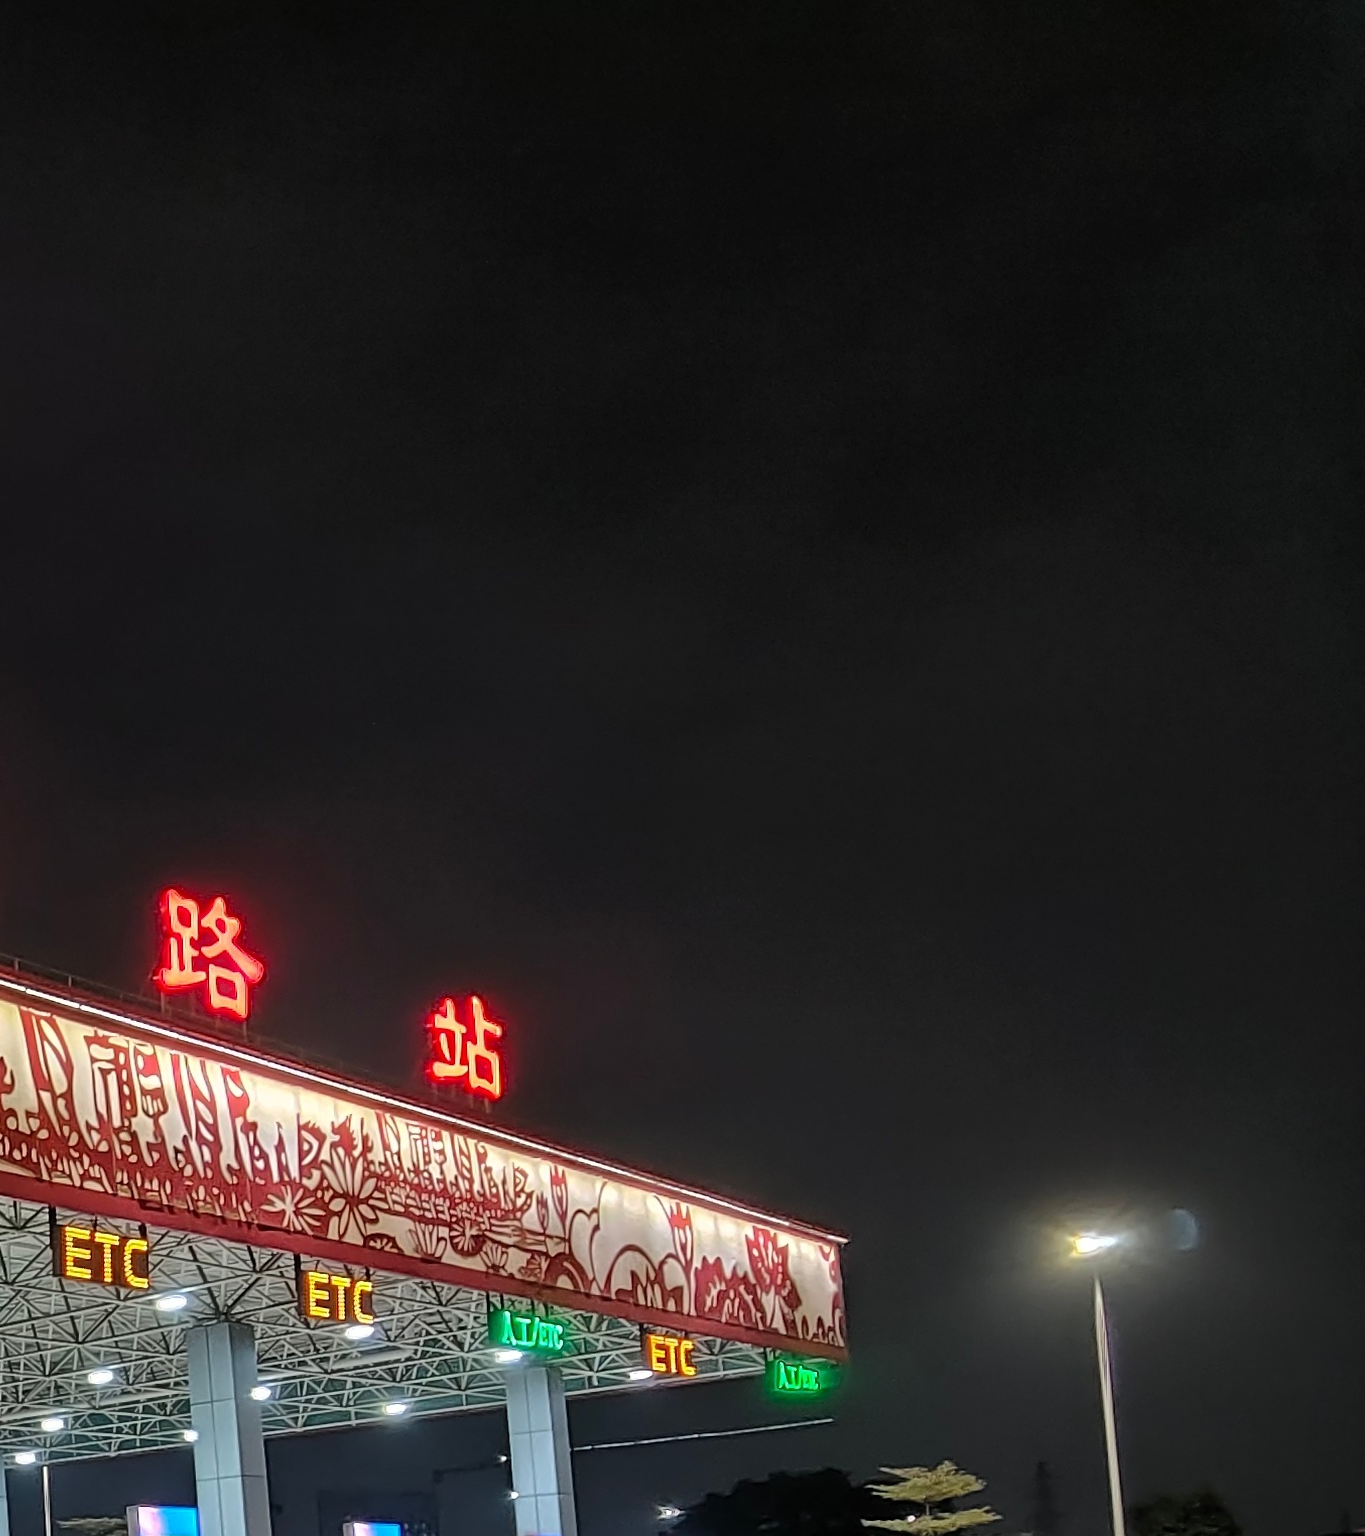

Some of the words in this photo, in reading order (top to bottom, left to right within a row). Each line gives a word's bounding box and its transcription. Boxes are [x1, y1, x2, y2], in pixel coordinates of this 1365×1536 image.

[65, 1226, 149, 1289] ETC
[309, 1271, 374, 1325] ETC
[650, 1335, 696, 1376] ETC
